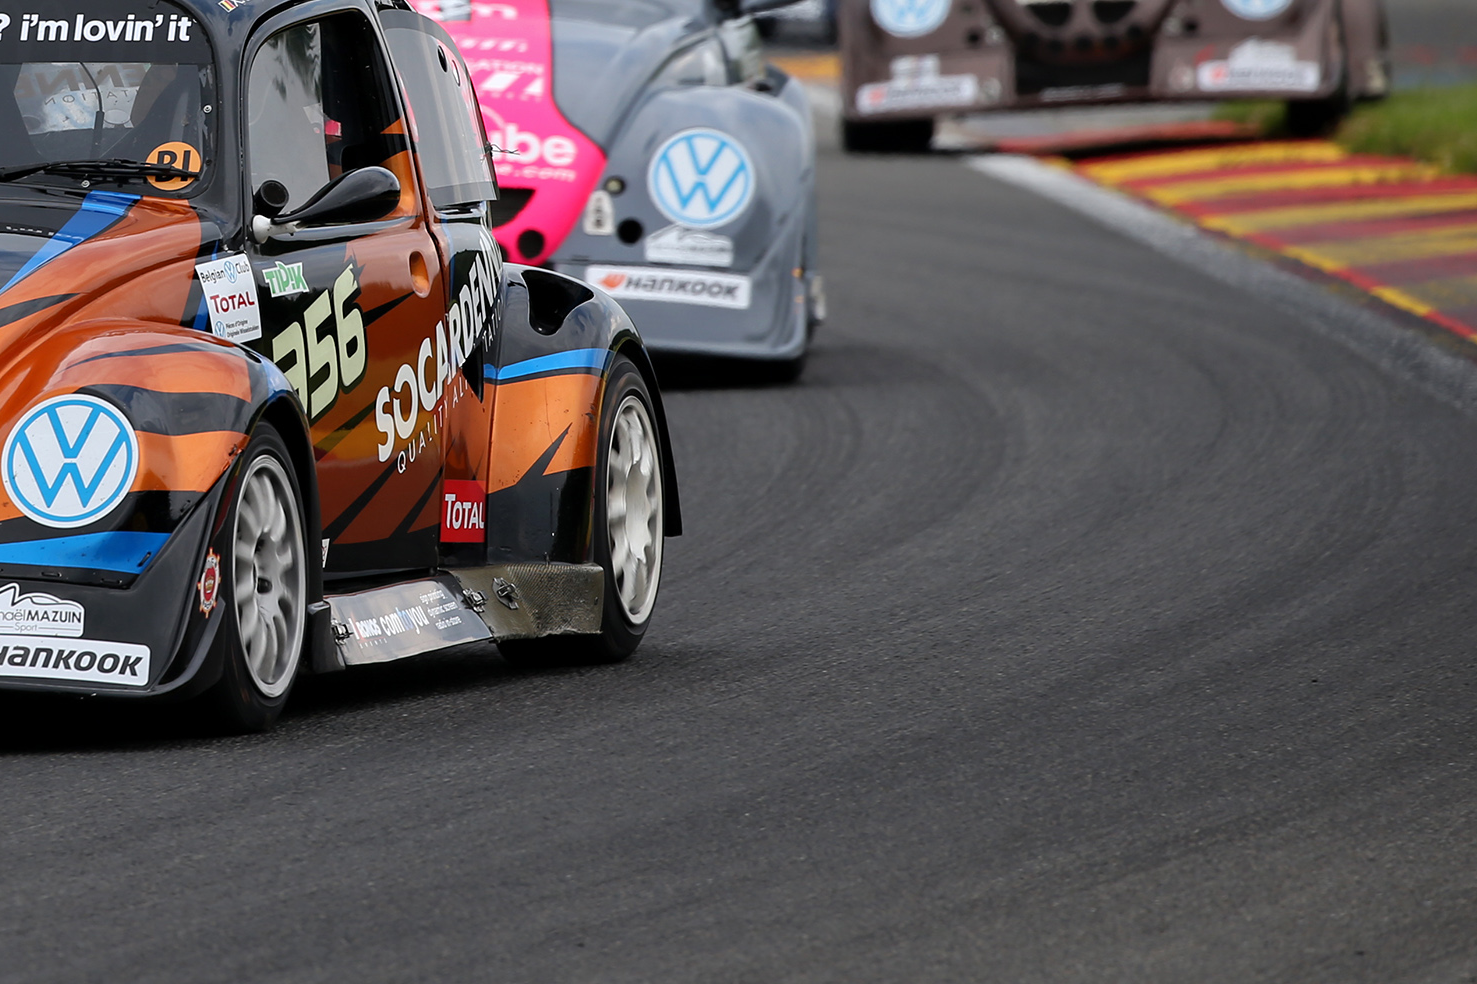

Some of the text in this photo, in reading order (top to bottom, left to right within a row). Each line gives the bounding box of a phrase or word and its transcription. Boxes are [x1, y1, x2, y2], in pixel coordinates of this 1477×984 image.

[19, 13, 68, 42] i'm
[73, 13, 161, 42] lovin'
[167, 13, 192, 42] it
[200, 268, 225, 284] Belgian
[235, 262, 250, 275] Club
[210, 291, 255, 314] TOTAL
[272, 263, 366, 419] 356
[444, 493, 485, 530] TOTAL
[14, 621, 38, 634] Sport
